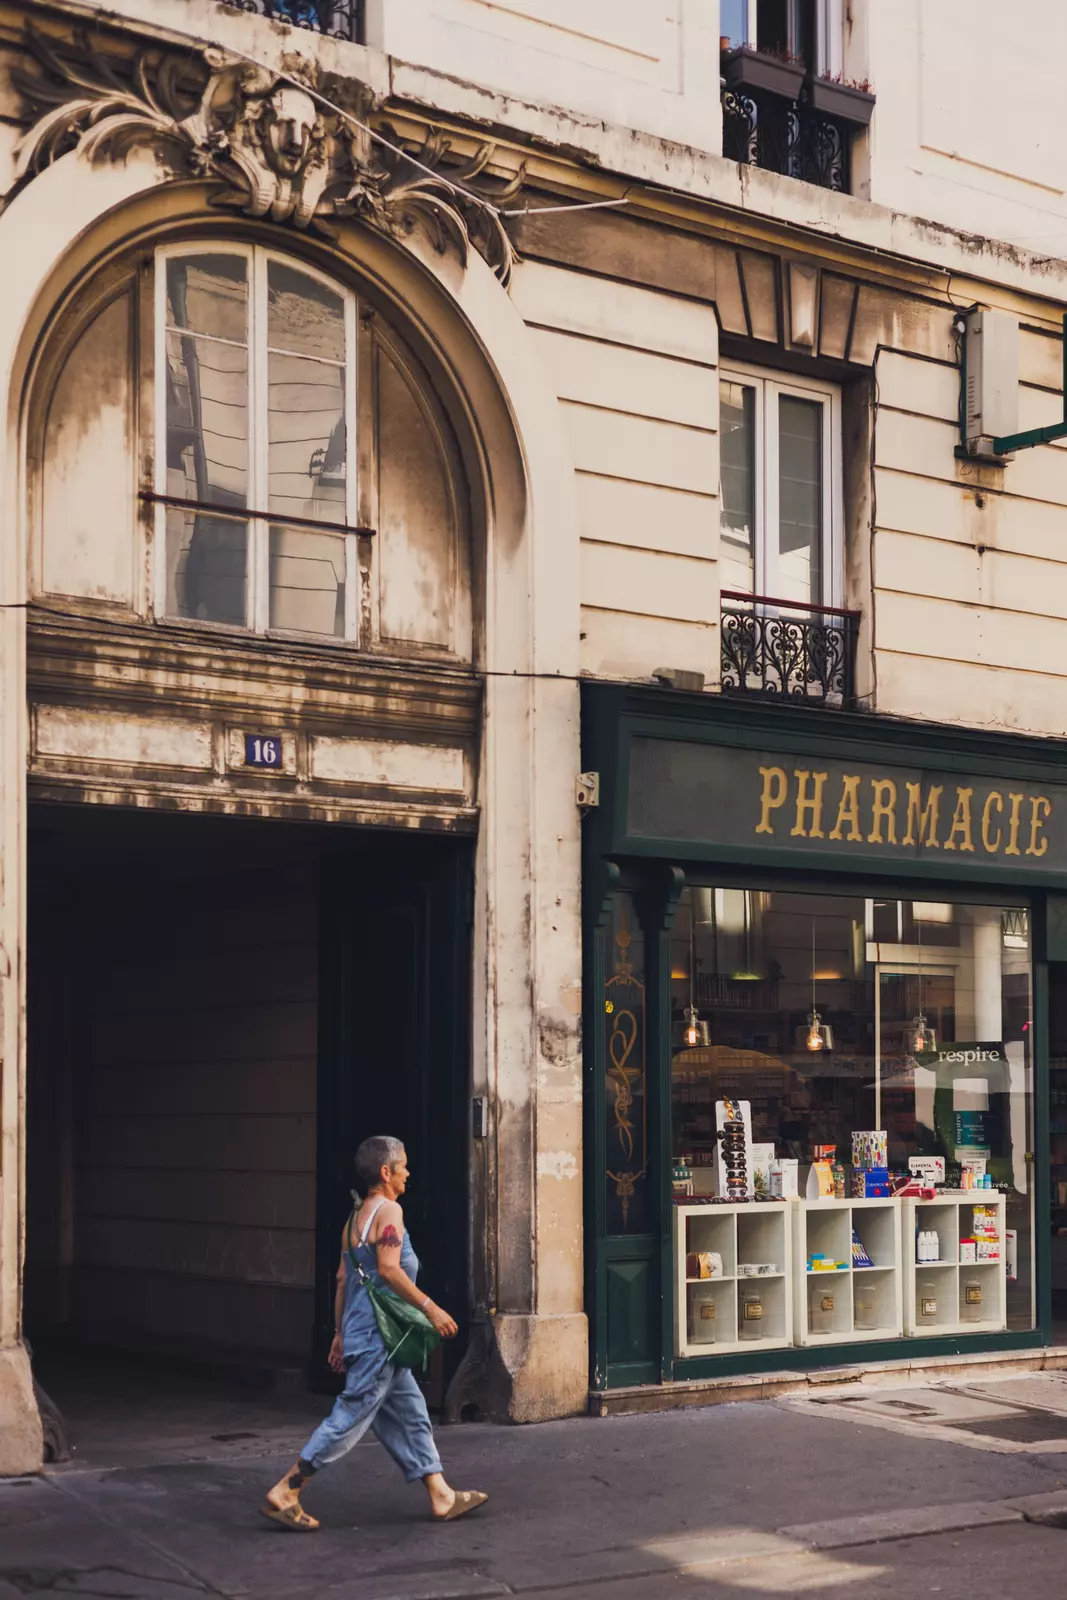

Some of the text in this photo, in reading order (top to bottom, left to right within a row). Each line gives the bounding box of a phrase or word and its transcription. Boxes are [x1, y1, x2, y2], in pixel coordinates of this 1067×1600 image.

[253, 739, 276, 764] 16
[755, 766, 1053, 857] PHARMACIE
[938, 1046, 1000, 1066] respire
